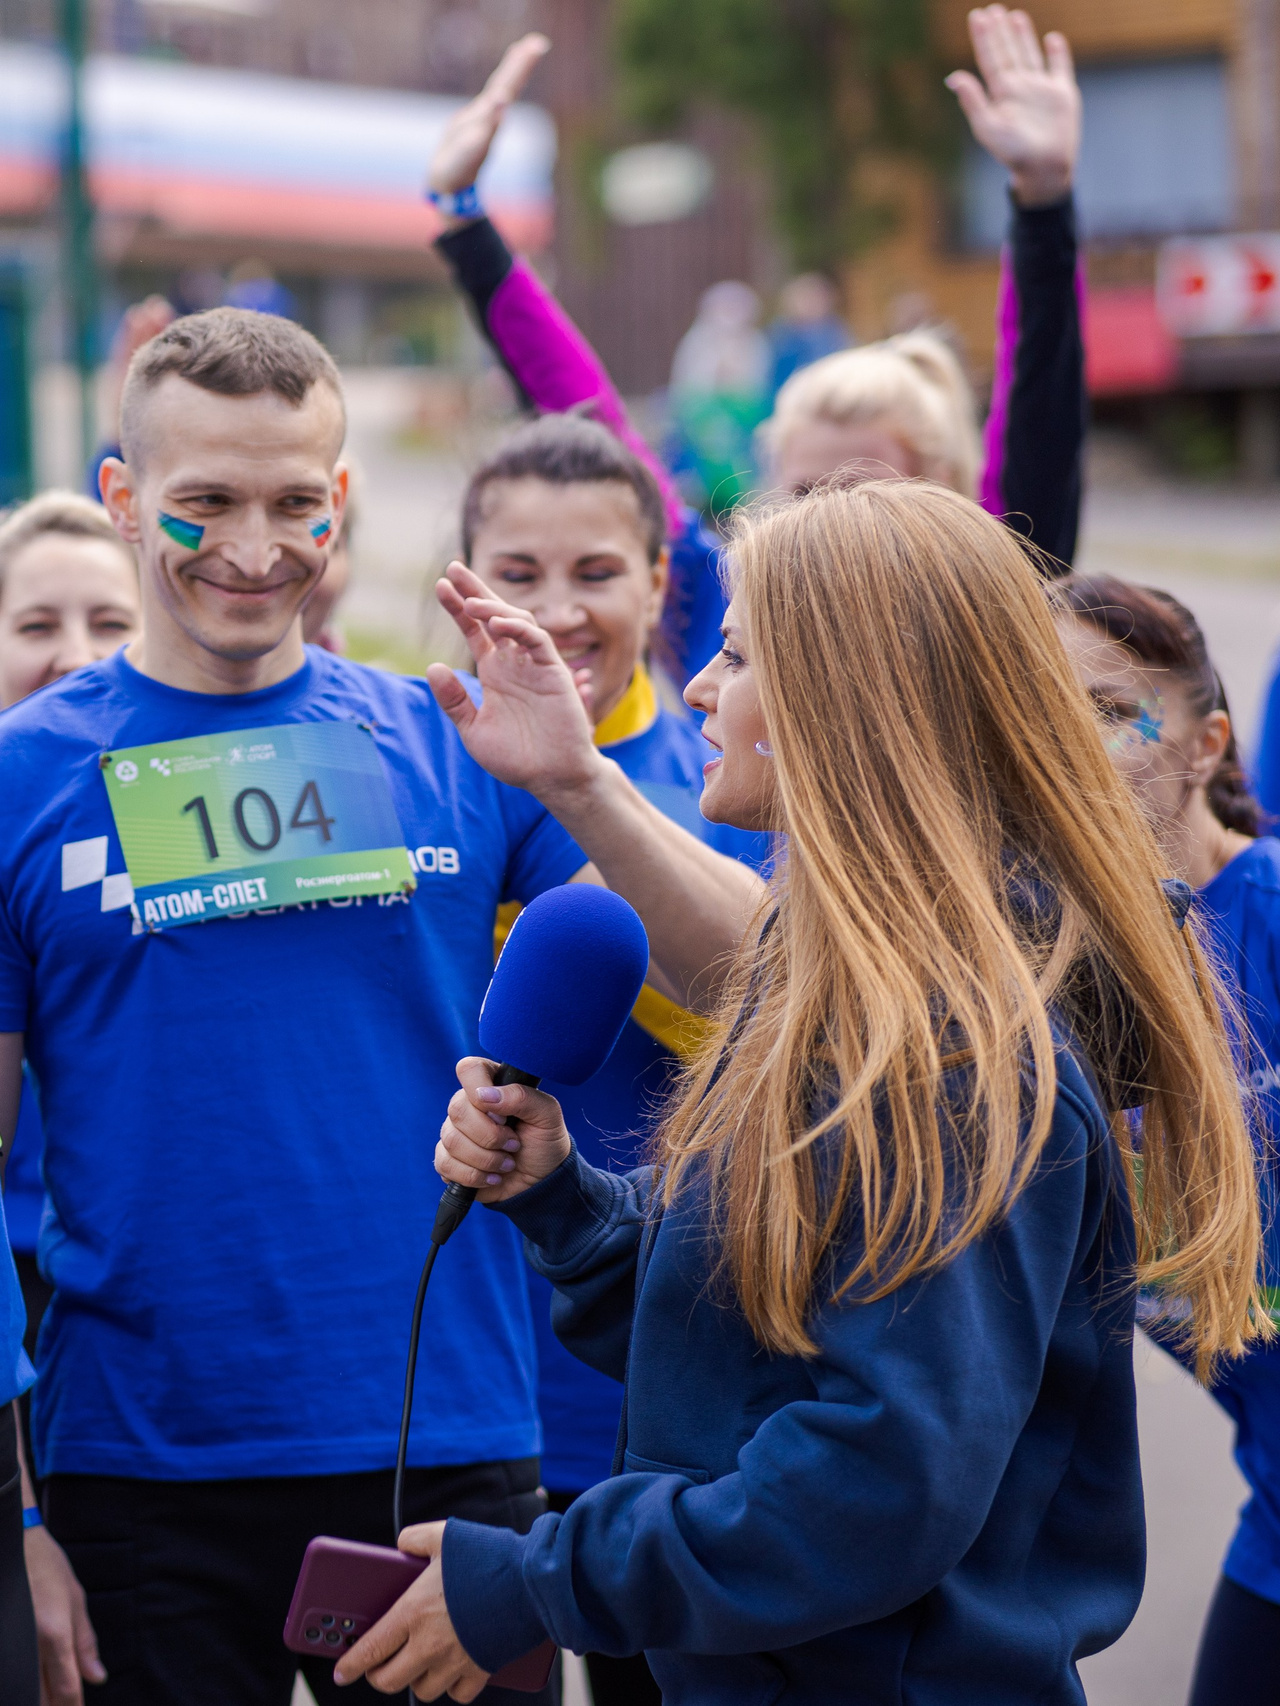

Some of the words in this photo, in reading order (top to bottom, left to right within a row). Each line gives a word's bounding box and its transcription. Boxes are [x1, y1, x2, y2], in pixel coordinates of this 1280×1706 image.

[182, 780, 335, 860] 104
[143, 877, 268, 923] АТОМ-СЛЕТ
[295, 868, 391, 888] Росэнергоатом-1
